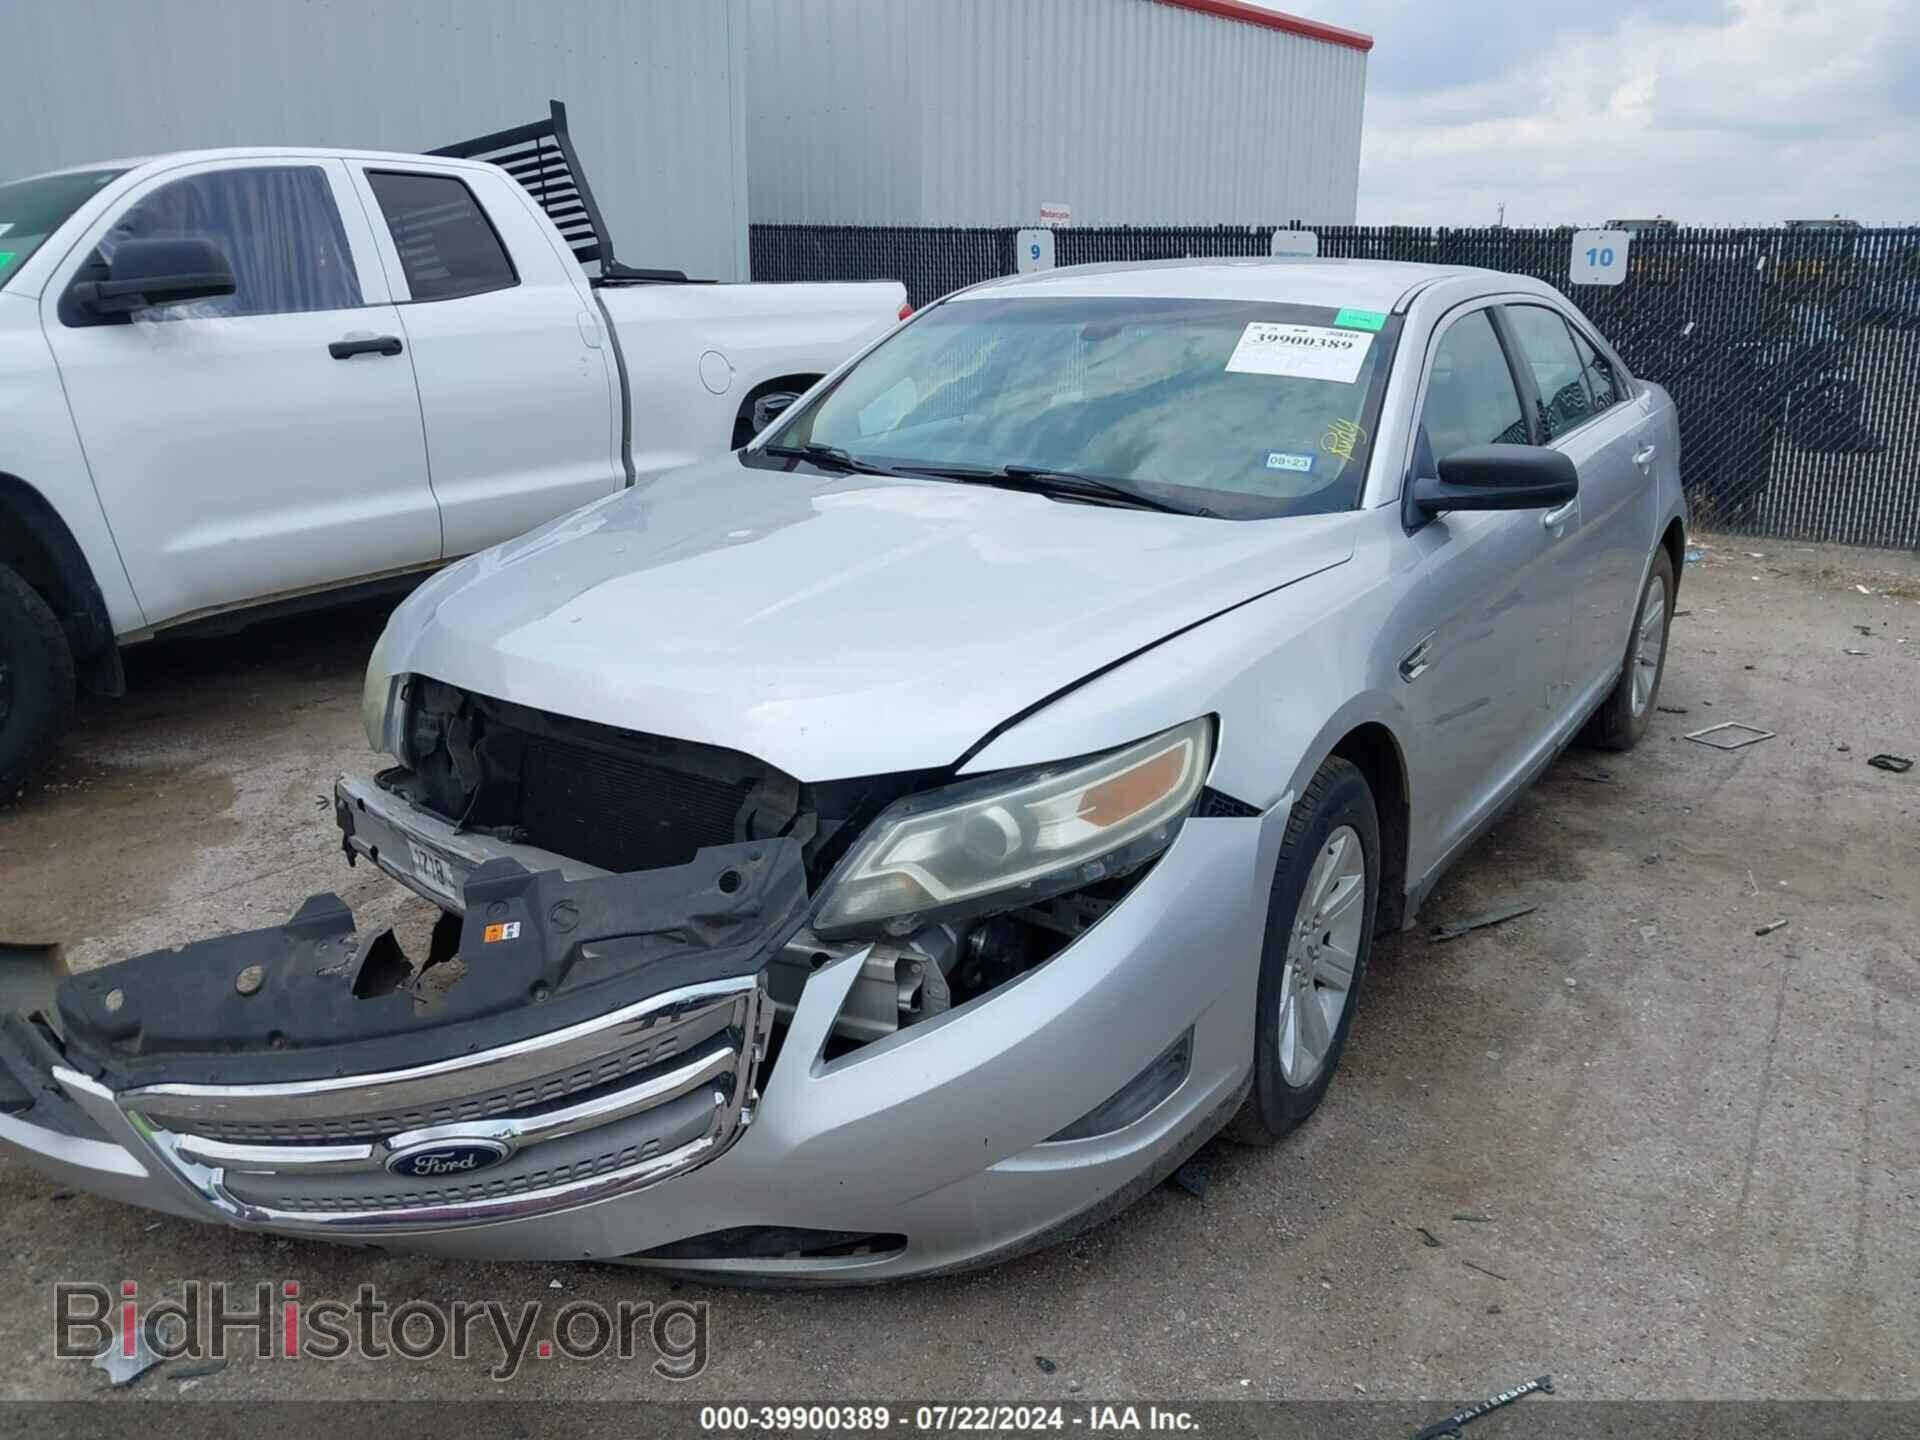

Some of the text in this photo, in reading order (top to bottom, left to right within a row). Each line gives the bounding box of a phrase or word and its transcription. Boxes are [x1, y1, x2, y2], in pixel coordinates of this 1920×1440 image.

[1031, 244, 1041, 260] 9
[1586, 247, 1614, 267] 10
[1254, 332, 1353, 350] 39900389
[413, 1151, 478, 1175] Ford
